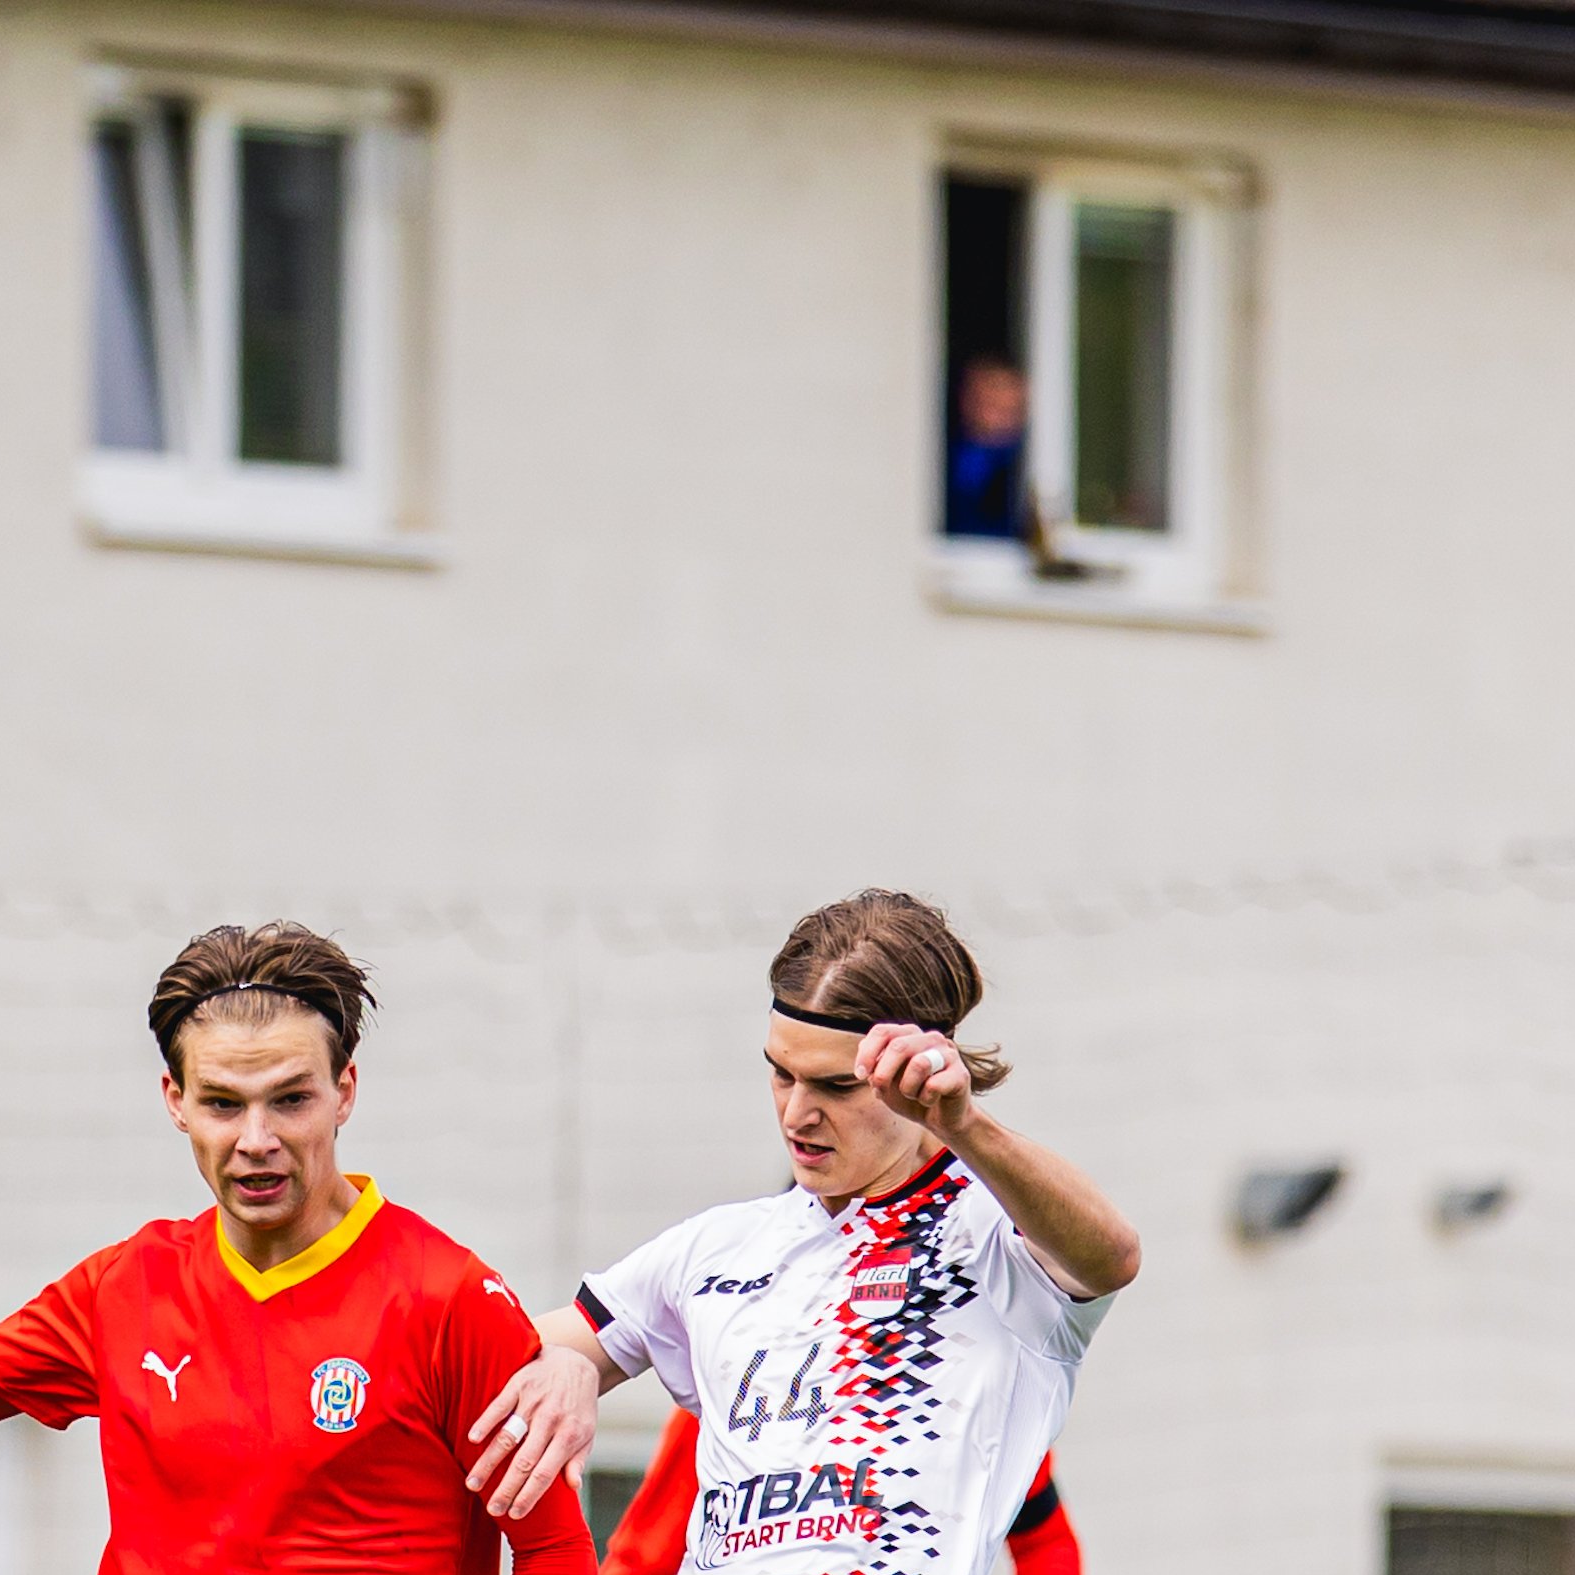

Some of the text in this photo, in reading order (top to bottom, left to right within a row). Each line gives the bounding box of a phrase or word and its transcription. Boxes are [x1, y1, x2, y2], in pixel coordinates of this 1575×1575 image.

[692, 1272, 774, 1297] Zeus
[854, 1285, 903, 1299] BRNO
[728, 1341, 827, 1443] 44
[721, 1510, 882, 1558] START BRNO
